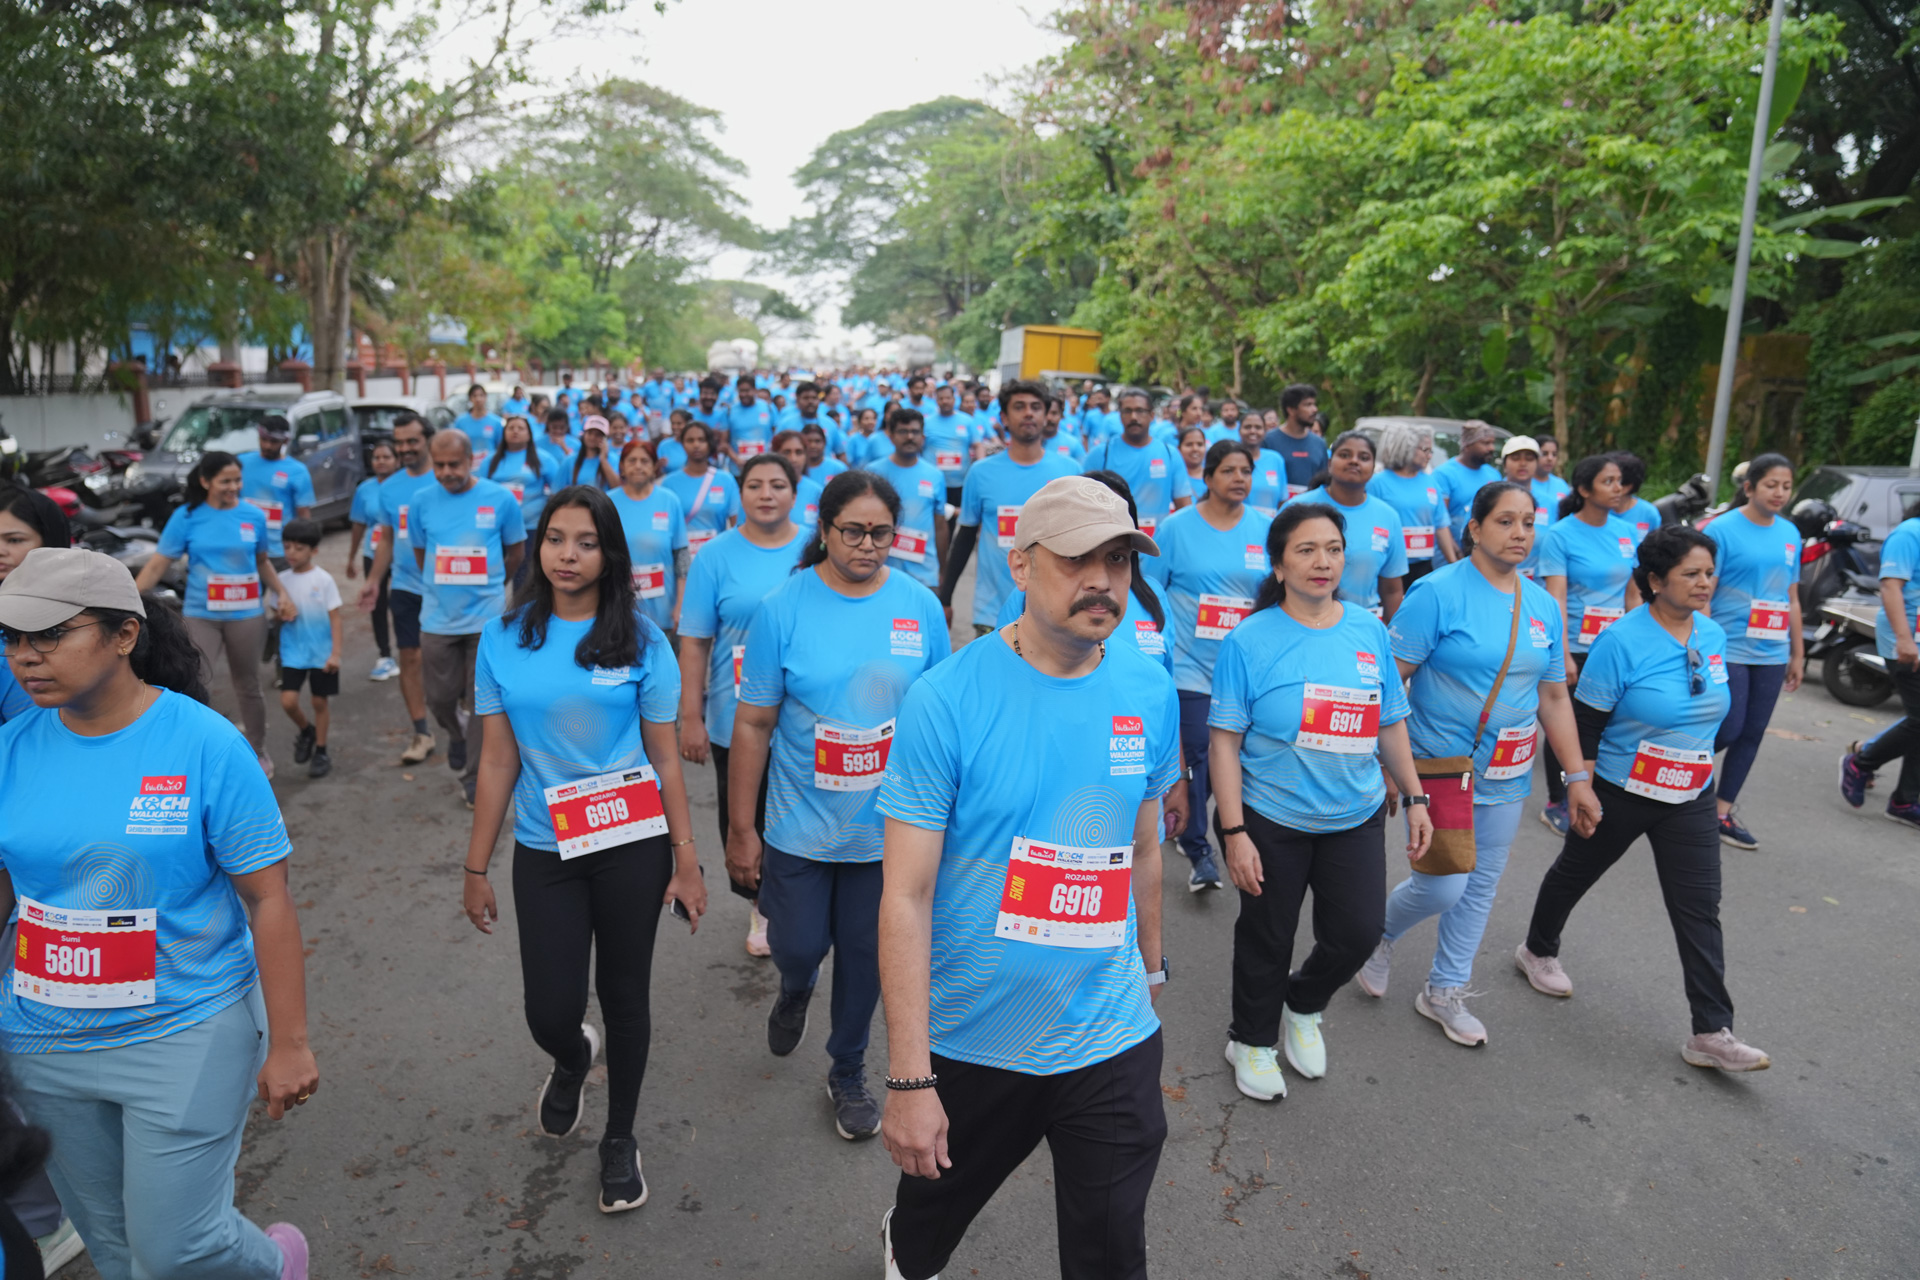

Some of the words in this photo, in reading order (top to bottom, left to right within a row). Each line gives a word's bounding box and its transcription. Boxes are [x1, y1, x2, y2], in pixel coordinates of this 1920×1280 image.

[1330, 710, 1363, 733] 6914
[1109, 737, 1147, 751] KOCHI
[842, 750, 880, 773] 5931
[1109, 751, 1145, 759] WALKATHON
[1656, 766, 1693, 788] 6966
[130, 796, 191, 810] KOCHI
[589, 791, 617, 802] ROZARIO
[585, 797, 629, 828] 6919
[1057, 851, 1084, 860] KOCHI
[1064, 873, 1098, 882] ROZARIO
[1009, 875, 1026, 901] 5KM
[1049, 883, 1103, 917] 6918
[45, 911, 68, 921] KOCHI
[18, 933, 28, 960] 5KM
[61, 935, 81, 943] Sumi
[45, 943, 101, 978] 5801
